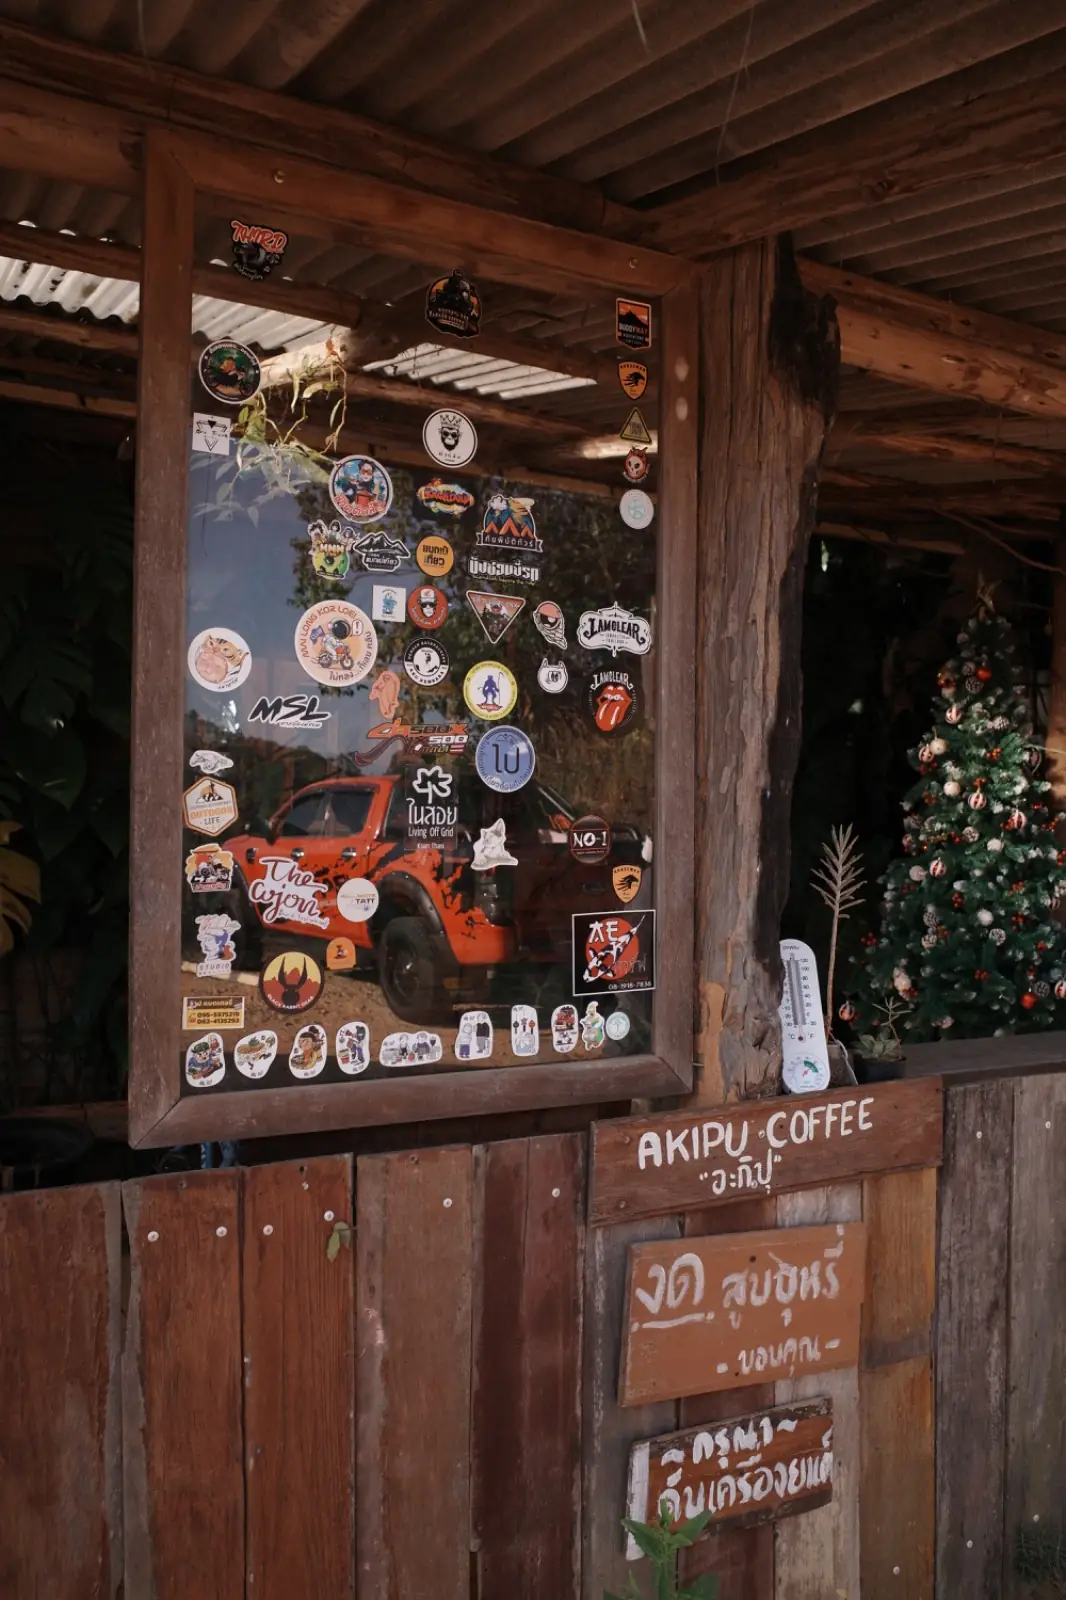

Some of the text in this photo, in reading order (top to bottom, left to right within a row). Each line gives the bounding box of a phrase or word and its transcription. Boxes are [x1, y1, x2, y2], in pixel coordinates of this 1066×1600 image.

[231, 220, 287, 253] THIRD
[317, 605, 337, 617] KOR
[249, 695, 330, 722] MSL
[204, 816, 221, 826] LIFE
[408, 827, 454, 839] Living Off Grid
[260, 858, 328, 890] The
[638, 1097, 874, 1169] AKIPU COFFEE
